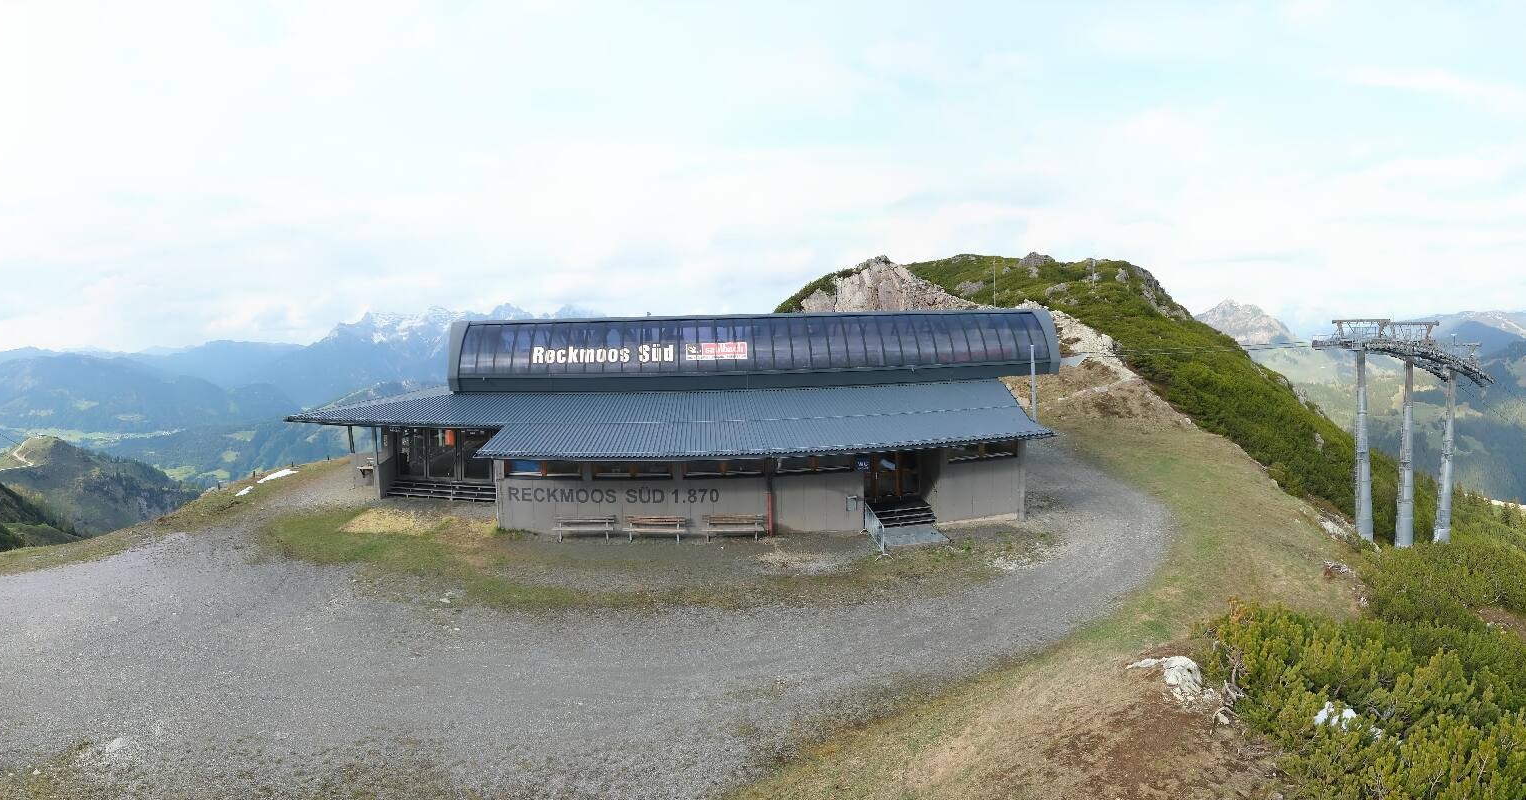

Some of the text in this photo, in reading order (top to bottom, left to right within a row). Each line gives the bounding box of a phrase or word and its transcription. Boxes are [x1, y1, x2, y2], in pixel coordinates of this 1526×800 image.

[532, 344, 674, 364] Reckmoos Süd
[508, 486, 720, 504] RECKMOOS SÜD 1.870
